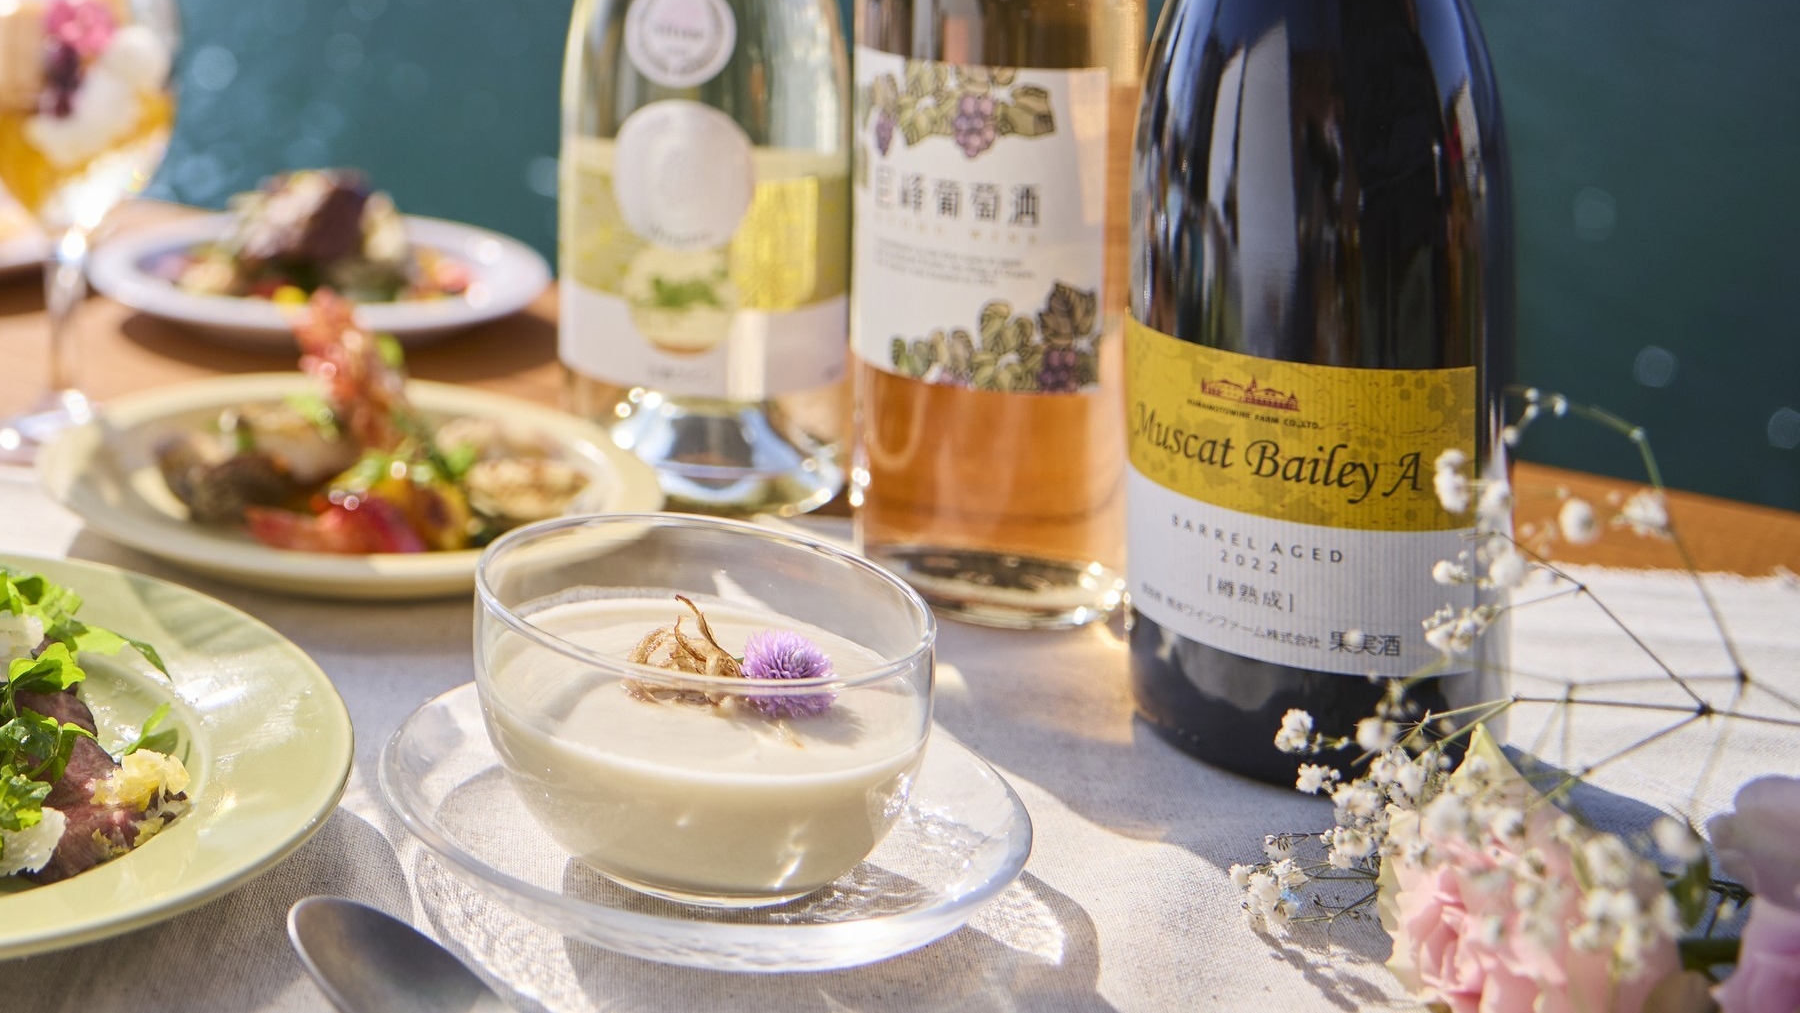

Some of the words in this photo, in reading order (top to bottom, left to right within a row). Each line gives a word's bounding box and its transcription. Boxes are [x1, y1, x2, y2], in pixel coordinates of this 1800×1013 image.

[1254, 414, 1279, 424] FARM
[1134, 400, 1235, 469] Muscat
[1245, 439, 1378, 504] Bailey
[1381, 451, 1423, 497] A
[1171, 513, 1256, 550] BARREL
[1270, 541, 1343, 564] AGED
[1220, 549, 1280, 574] 2022
[1329, 630, 1401, 657] 果実酒
